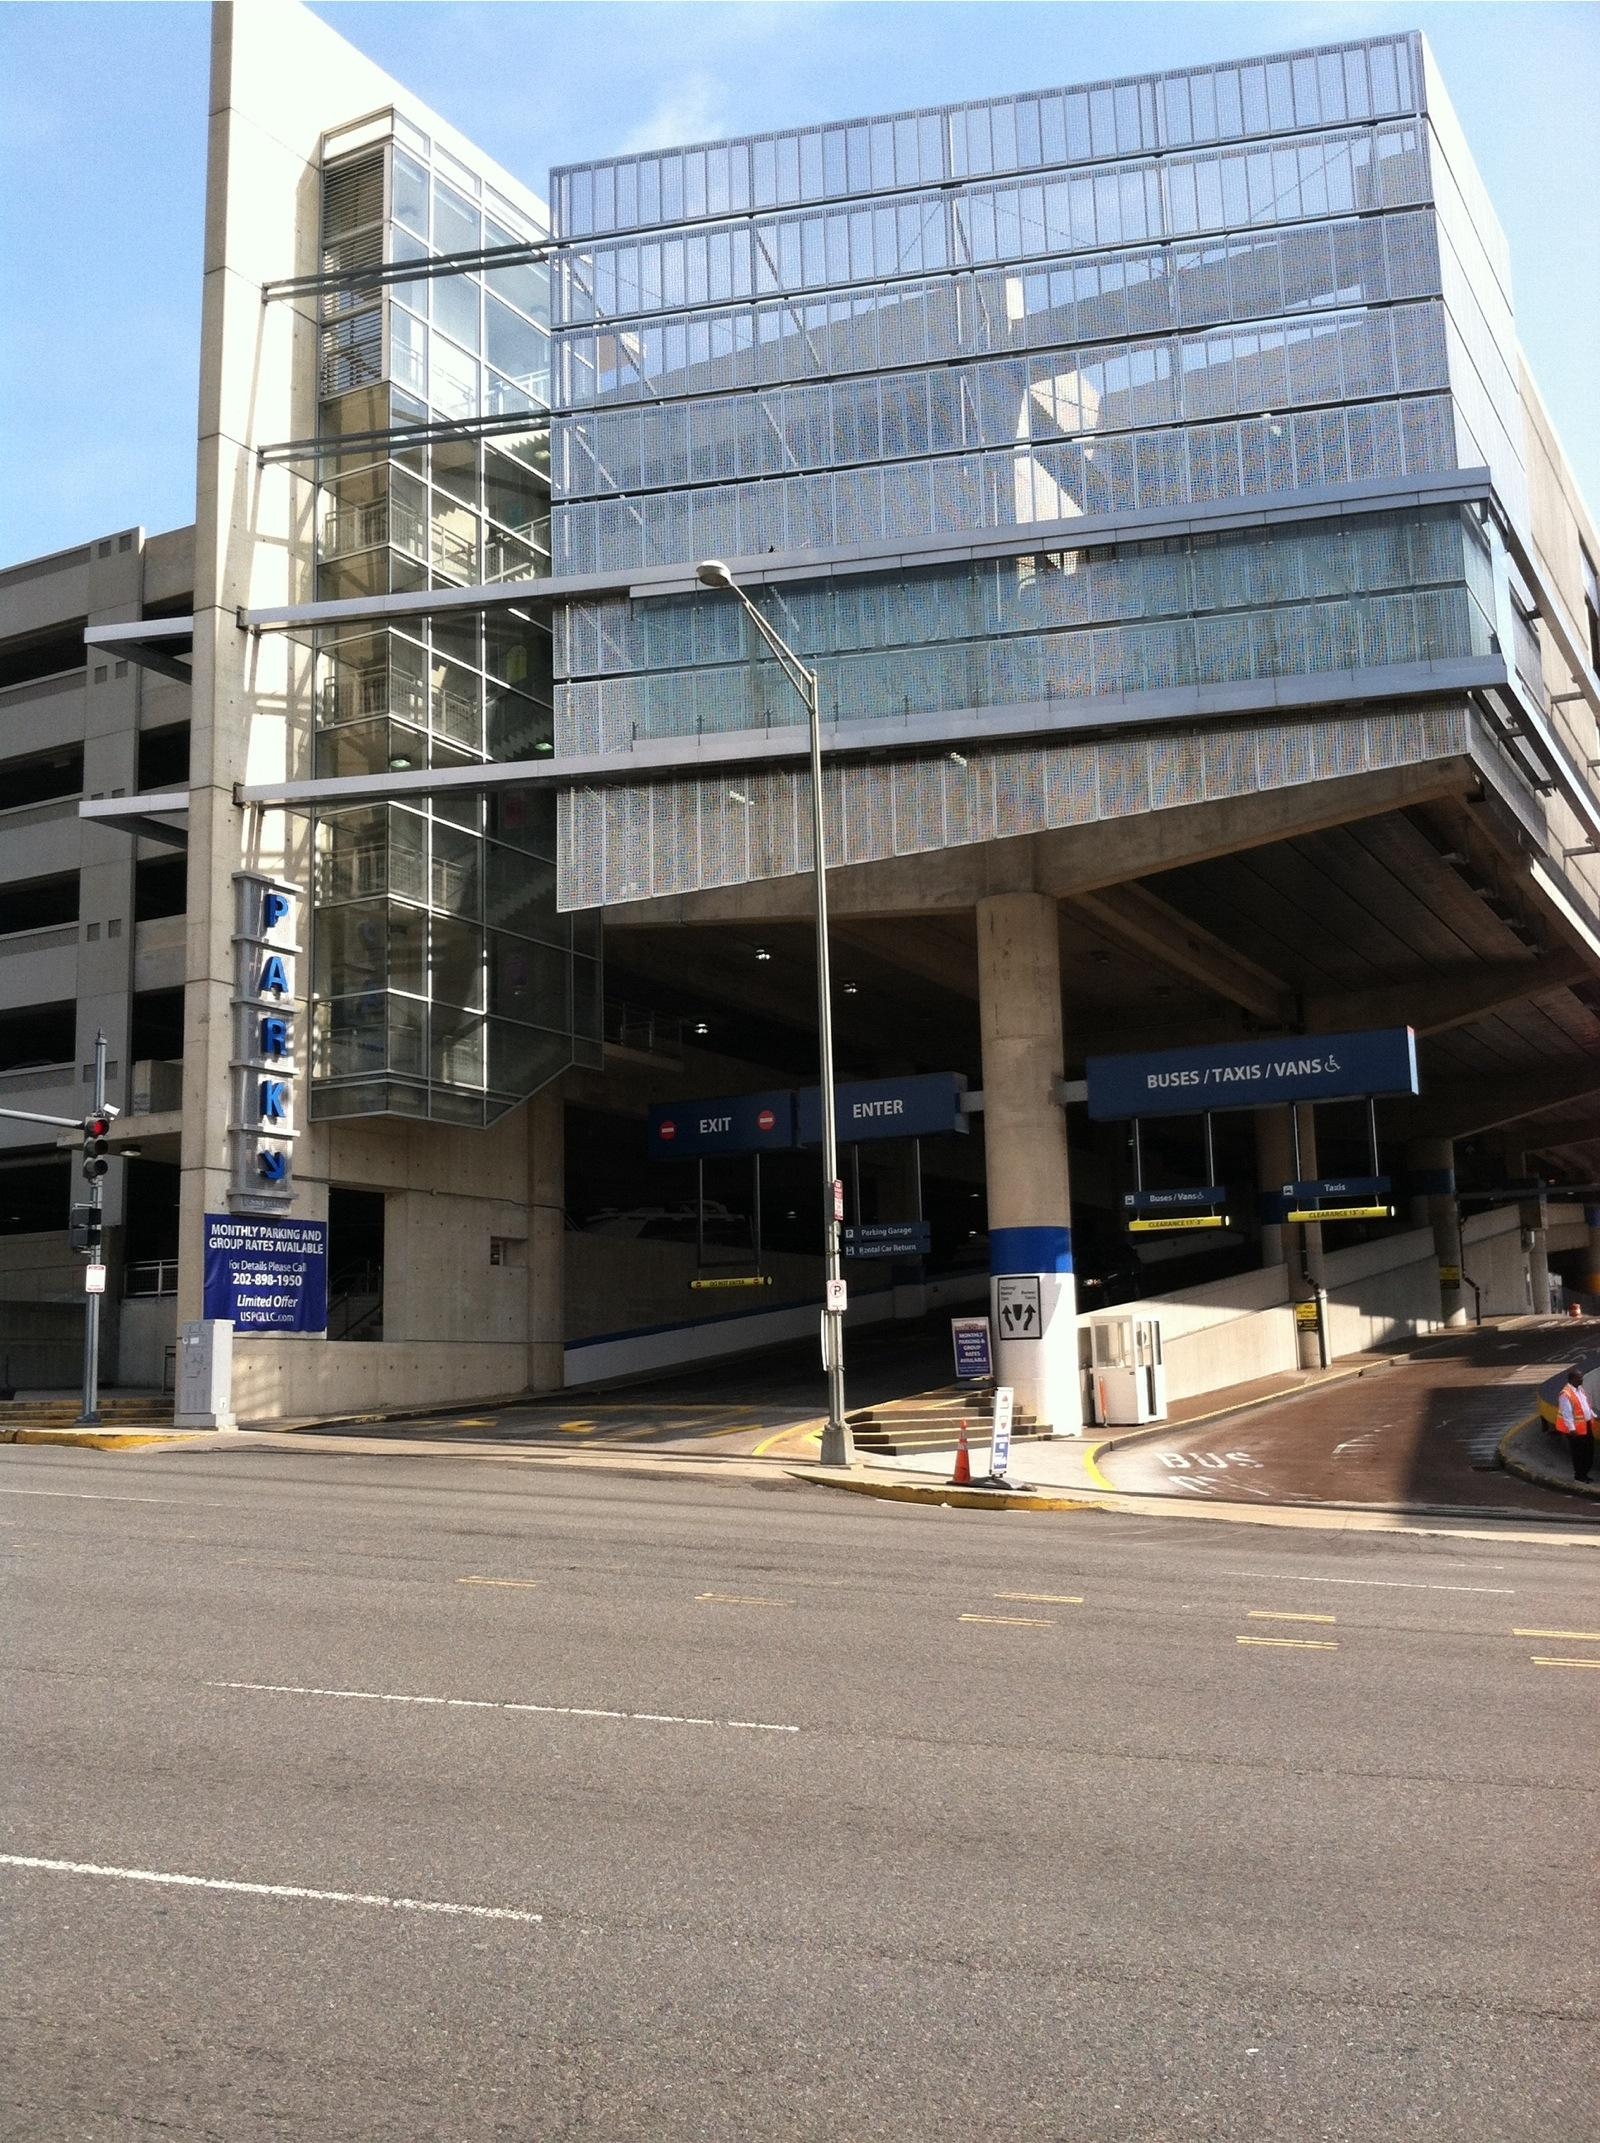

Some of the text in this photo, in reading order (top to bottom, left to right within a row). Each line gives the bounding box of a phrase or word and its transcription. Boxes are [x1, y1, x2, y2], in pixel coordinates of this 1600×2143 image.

[258, 893, 289, 1118] PARK
[1147, 1070, 1200, 1088] BUSES
[1212, 1065, 1261, 1083] TAXIS
[1274, 1059, 1322, 1077] VANS
[853, 1099, 904, 1118] ENTER
[700, 1117, 732, 1134] EXIT
[1324, 1183, 1346, 1192] Taxis
[1149, 1194, 1172, 1203] Buses
[1177, 1193, 1197, 1201] Vans
[1309, 1210, 1348, 1219] CLEARANCE
[1148, 1219, 1186, 1228] CLEARANCE
[211, 1224, 322, 1241] MONTHLY PARKING AND
[861, 1229, 887, 1237] Parking
[887, 1227, 912, 1236] Garage
[209, 1237, 323, 1254] GROUP RATES AVAILABLE
[893, 1244, 917, 1252] Return
[229, 1259, 307, 1272] For Details Please Call
[232, 1272, 302, 1287] 202-898-1950
[236, 1294, 298, 1308] Limited Offer
[1152, 1452, 1264, 1468] BUS
